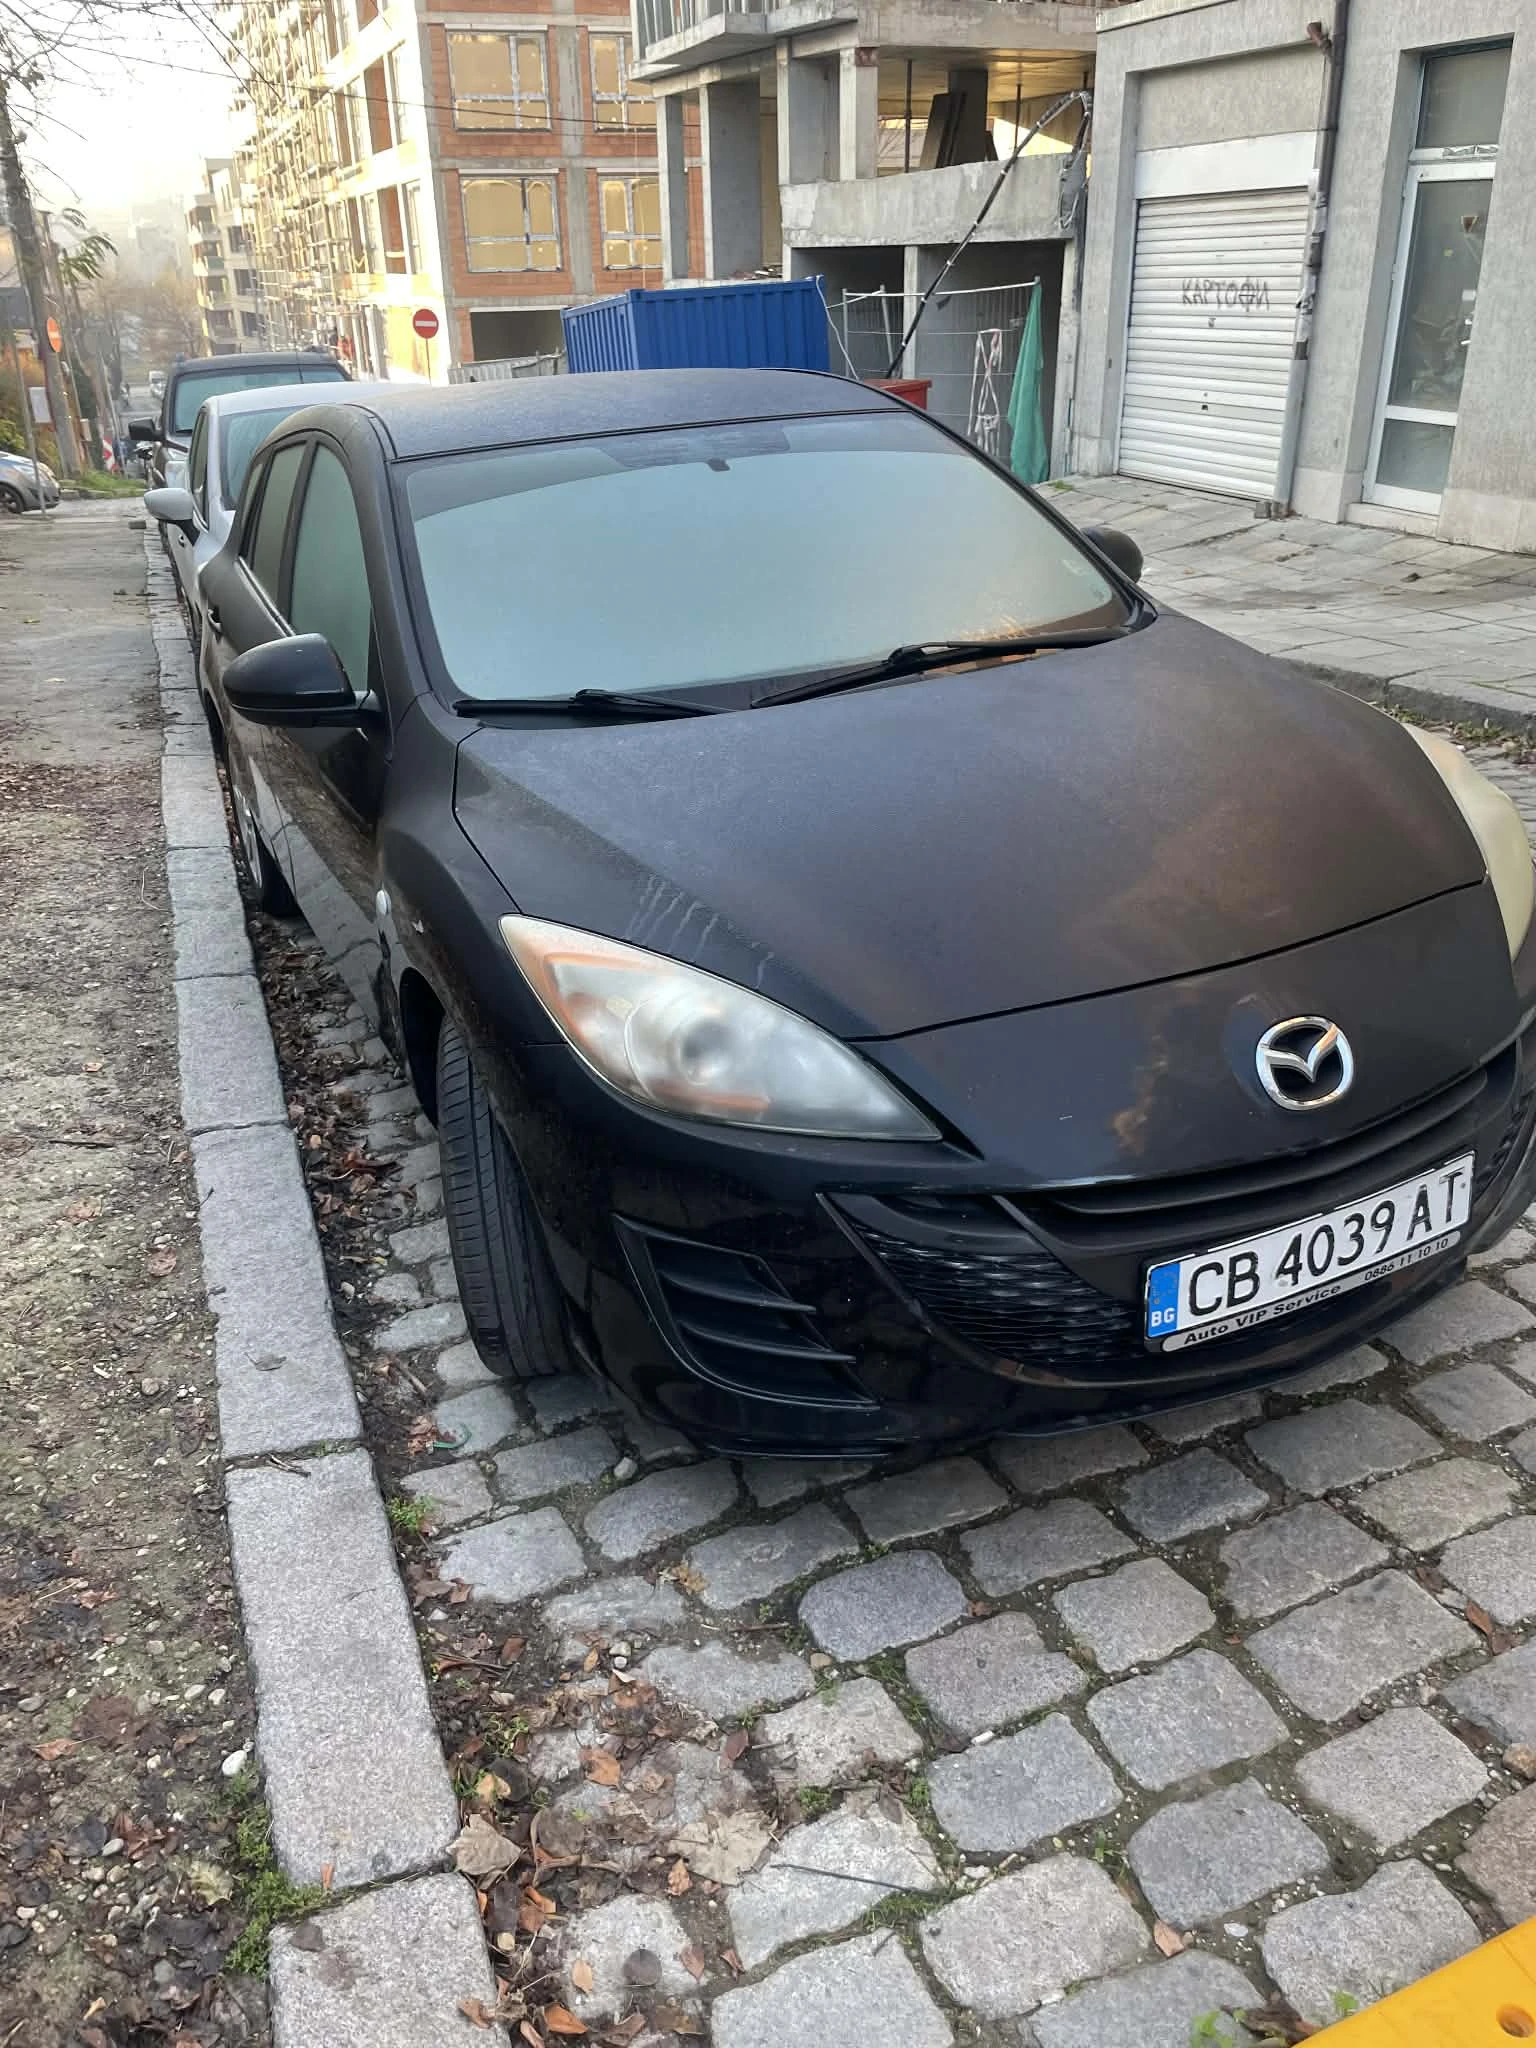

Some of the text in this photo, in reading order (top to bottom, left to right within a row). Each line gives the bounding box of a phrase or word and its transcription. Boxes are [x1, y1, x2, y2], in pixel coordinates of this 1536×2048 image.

[1182, 277, 1269, 312] КАРТОФИ
[1188, 1166, 1465, 1317] CB 4039 AT
[1151, 1307, 1176, 1327] BG
[1184, 1324, 1229, 1345] Auto
[1235, 1309, 1268, 1329] VIP
[1273, 1285, 1342, 1315] Service
[1364, 1263, 1395, 1281] 0886
[1418, 1246, 1431, 1259] 10
[1435, 1238, 1449, 1249] 10
